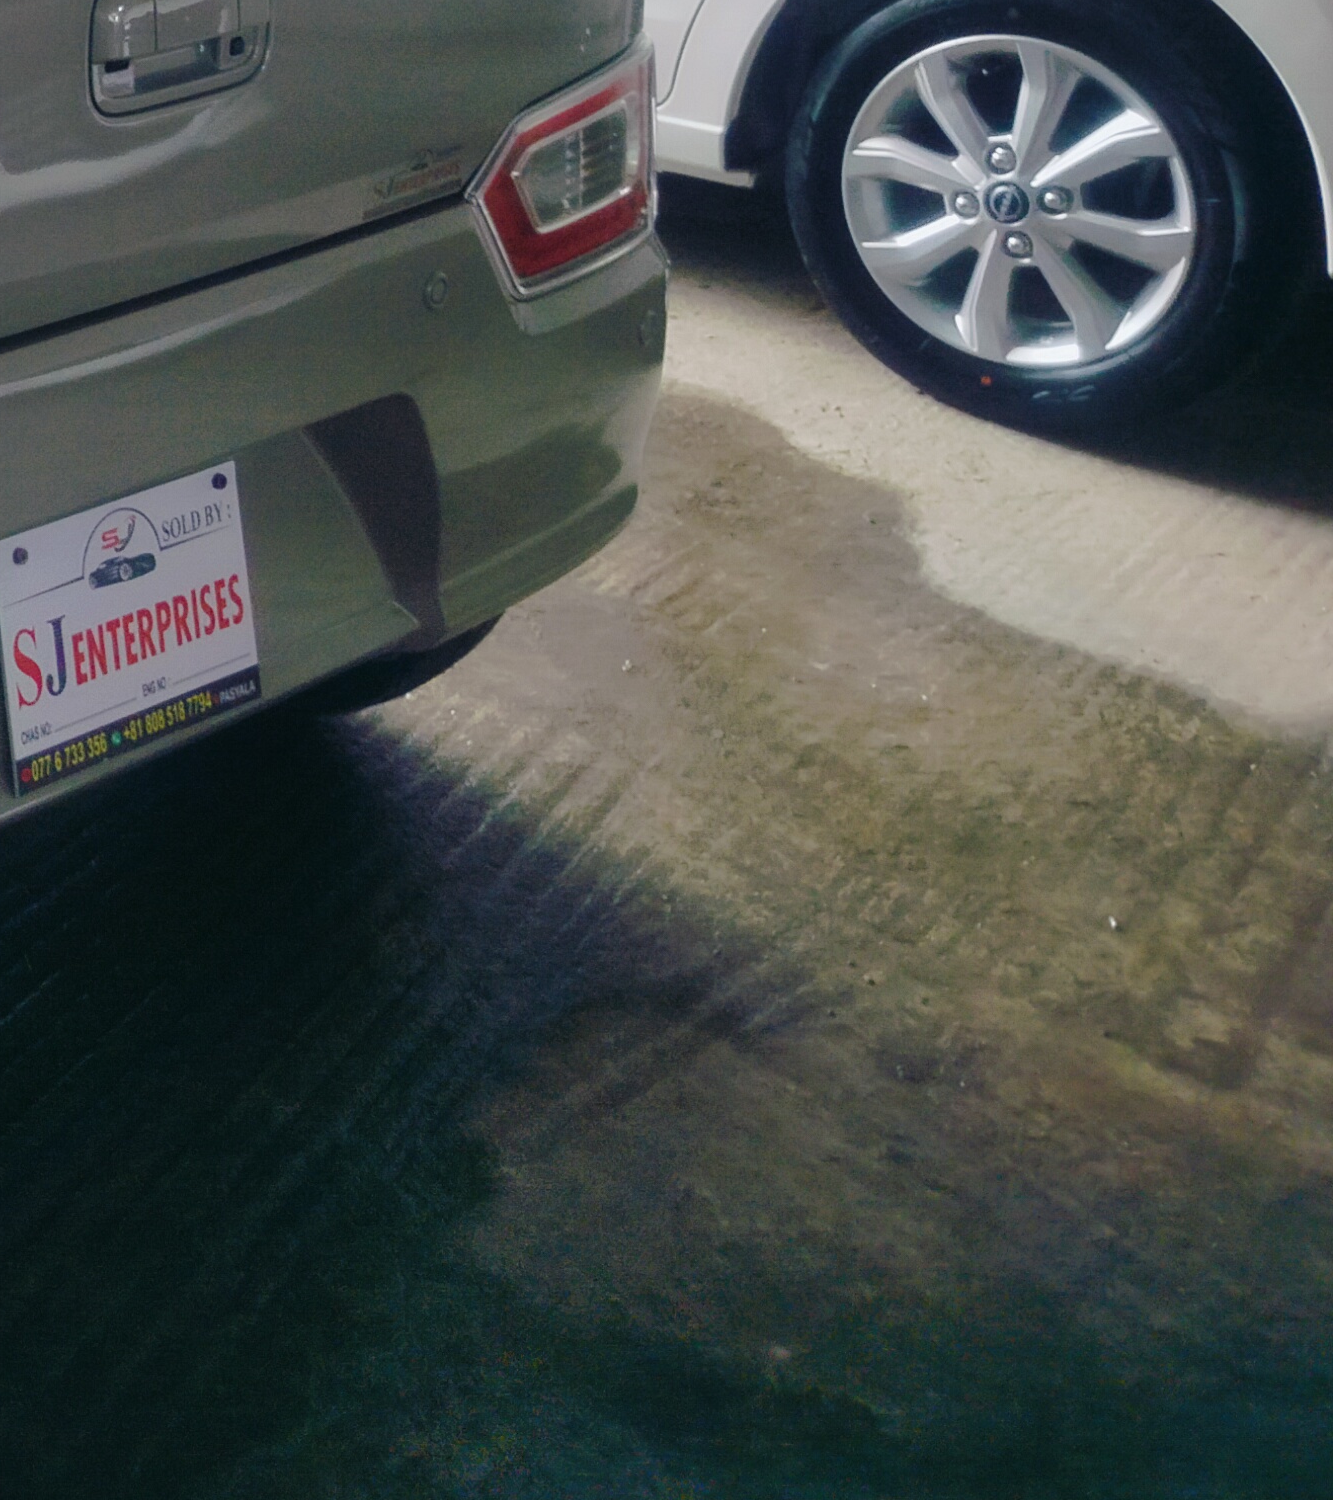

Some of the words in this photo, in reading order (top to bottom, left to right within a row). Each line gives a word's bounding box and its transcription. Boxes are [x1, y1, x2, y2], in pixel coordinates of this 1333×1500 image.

[161, 510, 201, 542] SOLD
[12, 615, 67, 711] SJ
[71, 573, 245, 686] ENTERPRISES
[32, 754, 51, 782] 077
[64, 741, 86, 768] 733
